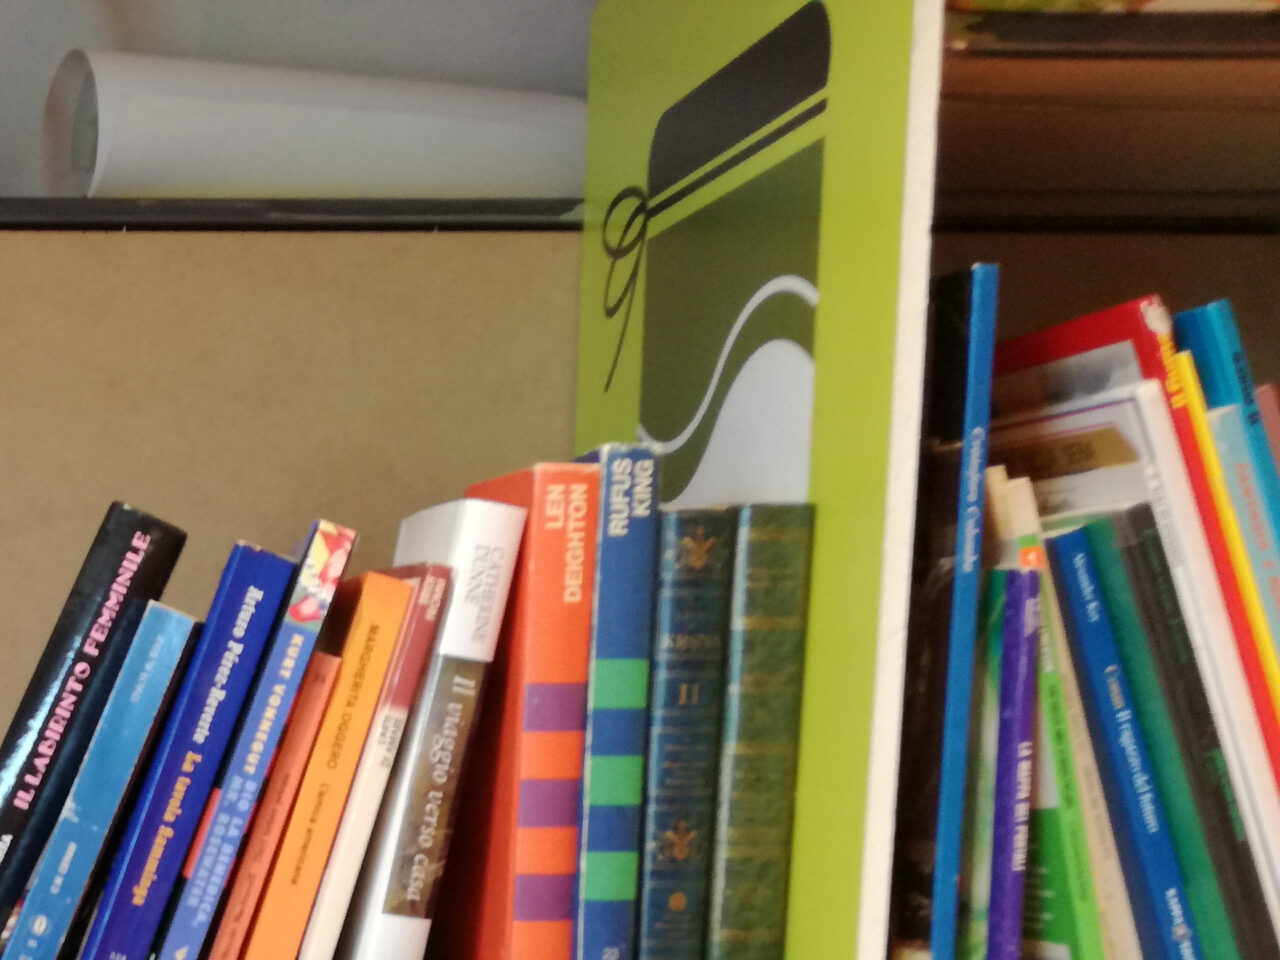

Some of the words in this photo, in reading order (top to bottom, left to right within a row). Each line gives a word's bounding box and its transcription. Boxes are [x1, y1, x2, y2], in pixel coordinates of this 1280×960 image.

[546, 485, 566, 531] LEN
[609, 457, 633, 537] RUFUS
[632, 459, 655, 517] KING
[564, 482, 589, 603] DEIGHTON
[79, 529, 154, 658] FEMMINILE
[463, 543, 490, 604] DUNNE
[470, 545, 505, 644] CATHERINE
[229, 584, 264, 641] Arturo
[275, 631, 307, 680] KURT
[342, 621, 383, 710] MARGHERITA
[450, 674, 477, 696] Il
[20, 658, 95, 787] LABIRINTO
[191, 638, 245, 746] Pérez-Reverte
[237, 680, 290, 775] VONNEGUT
[324, 710, 354, 771] OGGERO
[424, 699, 468, 786] viaggio
[180, 750, 202, 775] La
[12, 784, 36, 811] IL
[161, 774, 193, 826] tavola
[234, 777, 258, 813] DIO
[416, 788, 444, 849] verso
[225, 815, 244, 839] LA
[287, 825, 317, 887] americana
[185, 811, 231, 909] ROSEWATER
[404, 852, 430, 903] casa
